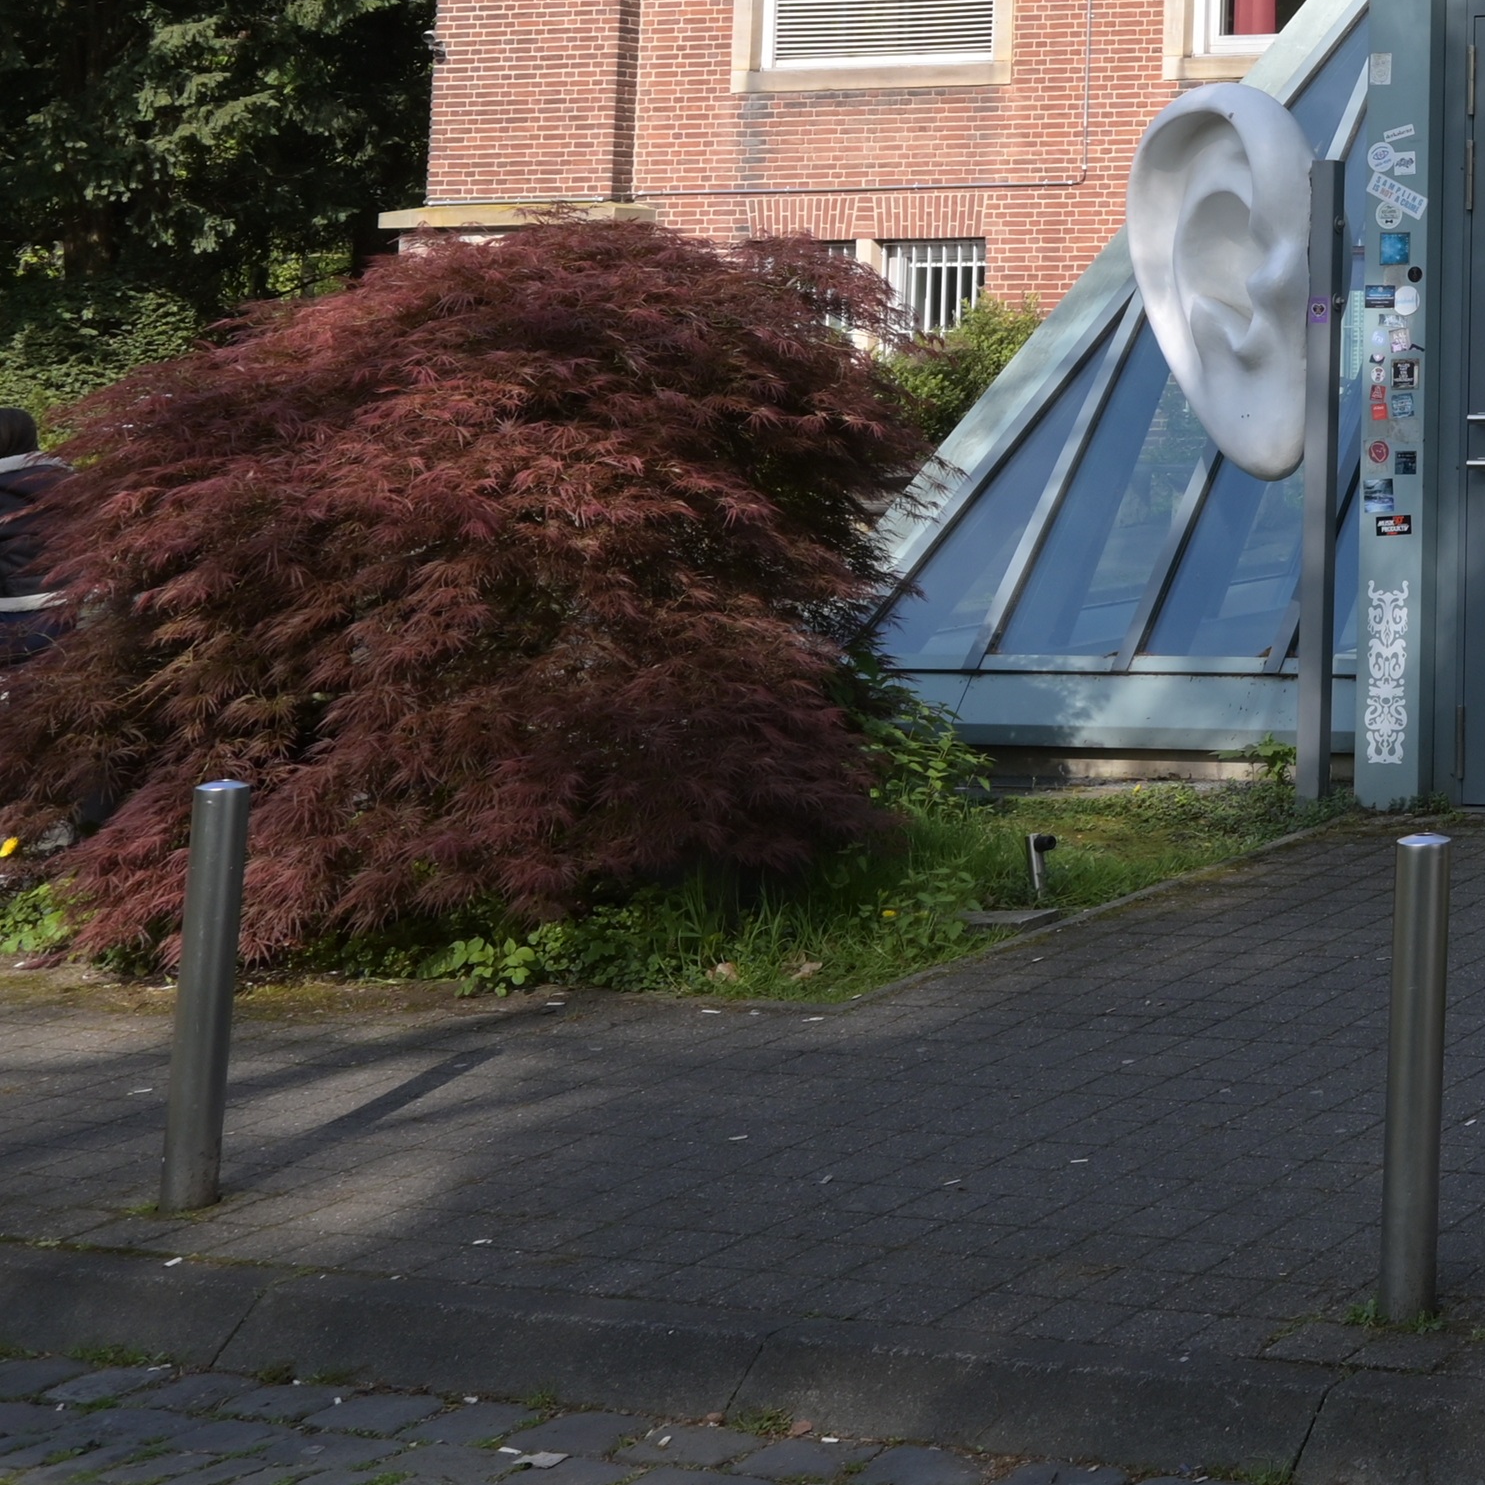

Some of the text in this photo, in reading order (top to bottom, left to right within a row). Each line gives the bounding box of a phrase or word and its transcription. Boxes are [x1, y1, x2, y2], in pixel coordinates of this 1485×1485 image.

[1372, 183, 1421, 214] IS NOT A CRIME
[1376, 175, 1424, 206] SAMPLING
